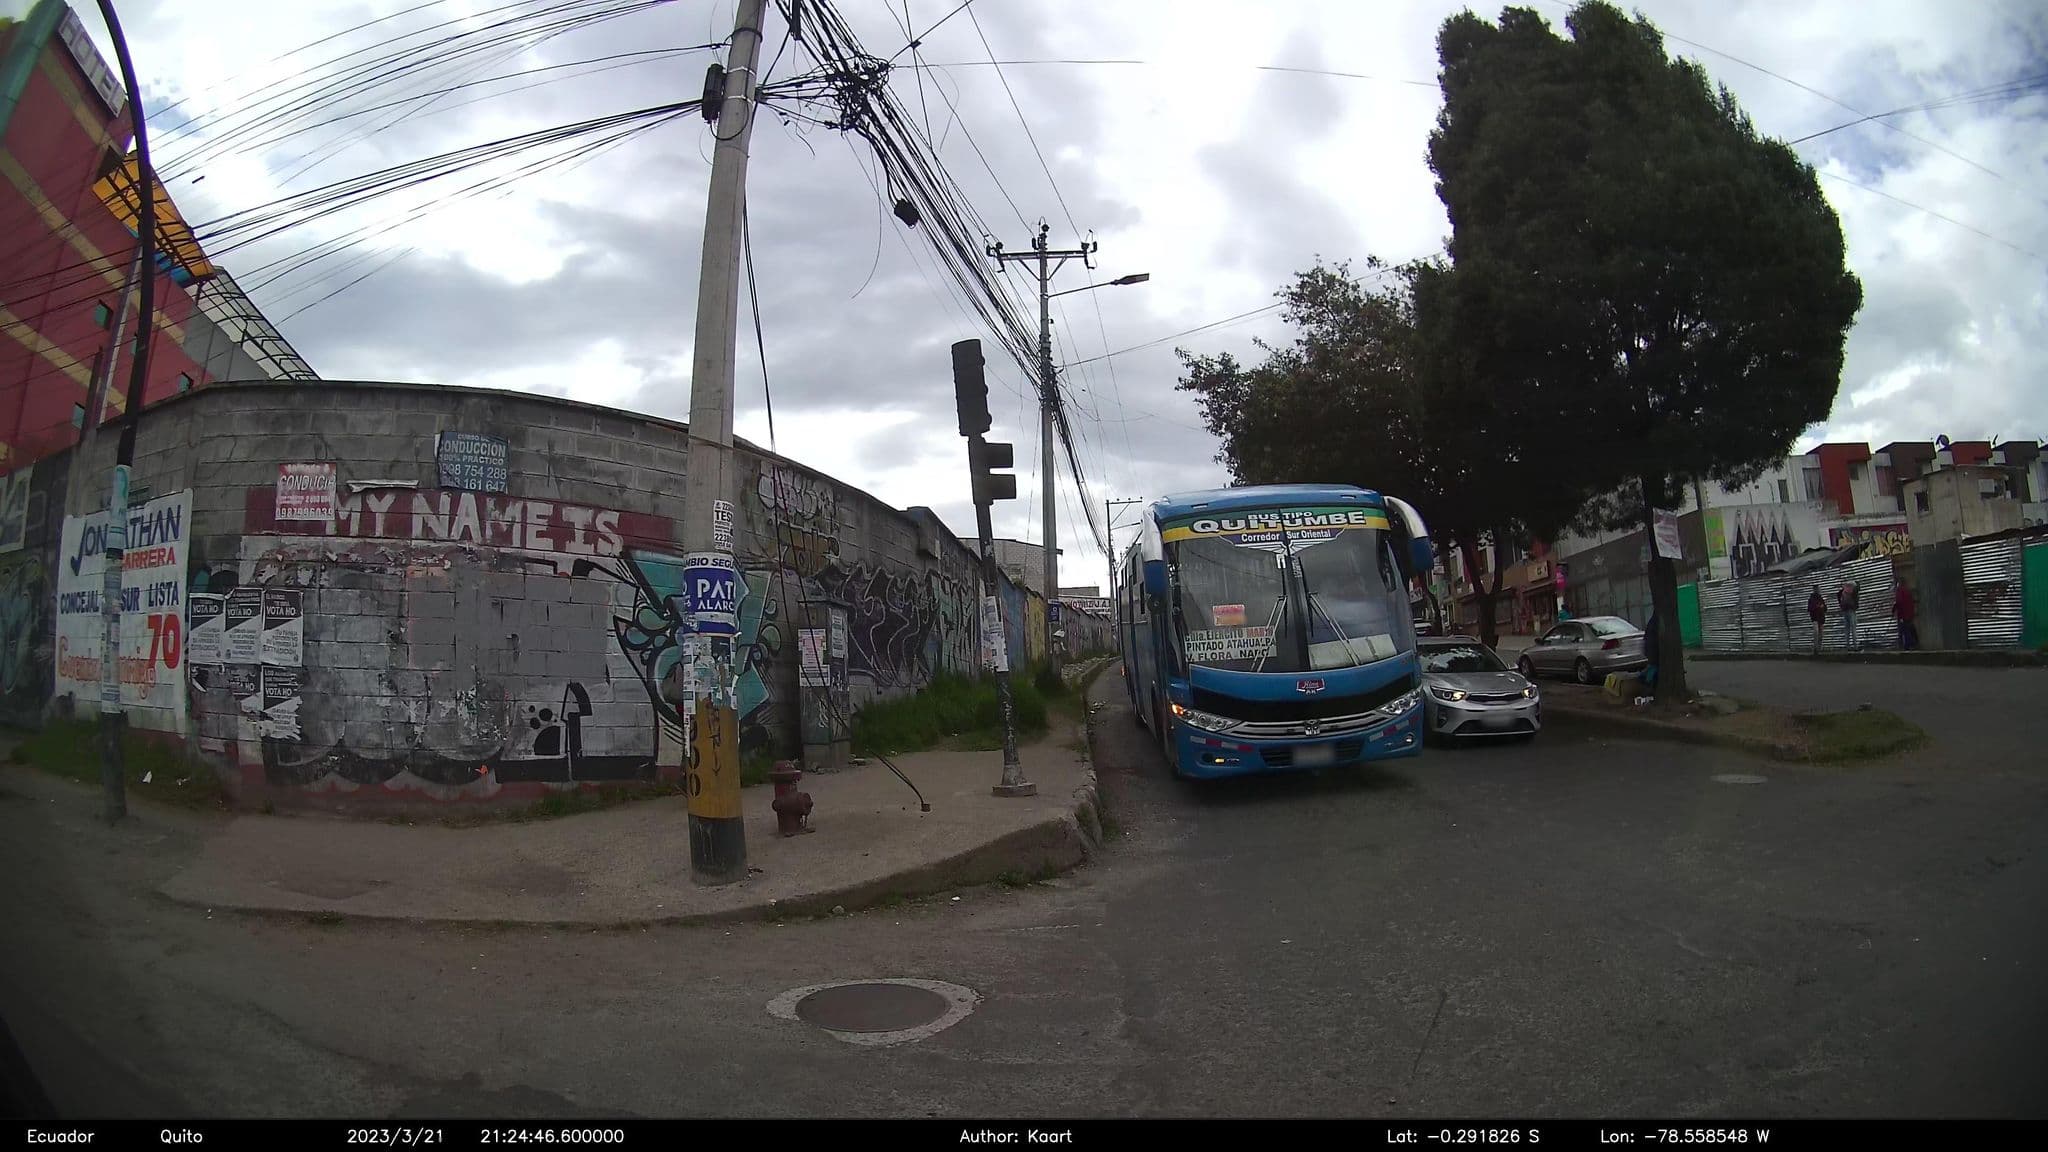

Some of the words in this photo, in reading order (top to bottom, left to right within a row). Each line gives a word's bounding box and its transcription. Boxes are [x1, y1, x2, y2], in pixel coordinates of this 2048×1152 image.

[465, 464, 484, 477] 754
[487, 466, 507, 480] 288
[464, 478, 482, 490] 161
[486, 480, 506, 492] 647
[1192, 511, 1367, 533] QUITUMBE
[1248, 513, 1279, 521] BUS
[1283, 511, 1312, 520] TIPO
[325, 492, 396, 537] MY
[412, 491, 554, 551] NAME
[562, 505, 624, 557] IS
[1241, 532, 1280, 543] Corredor
[1287, 530, 1300, 540] Sur
[1301, 528, 1331, 539] Oriental
[148, 581, 179, 607] LISTA
[266, 606, 284, 616] VOTA
[147, 613, 181, 669] 70
[1186, 641, 1223, 652] PINTADO
[1227, 637, 1275, 648] ATAHUALPA
[1198, 652, 1232, 661] FLORA
[266, 687, 282, 697] VOTA
